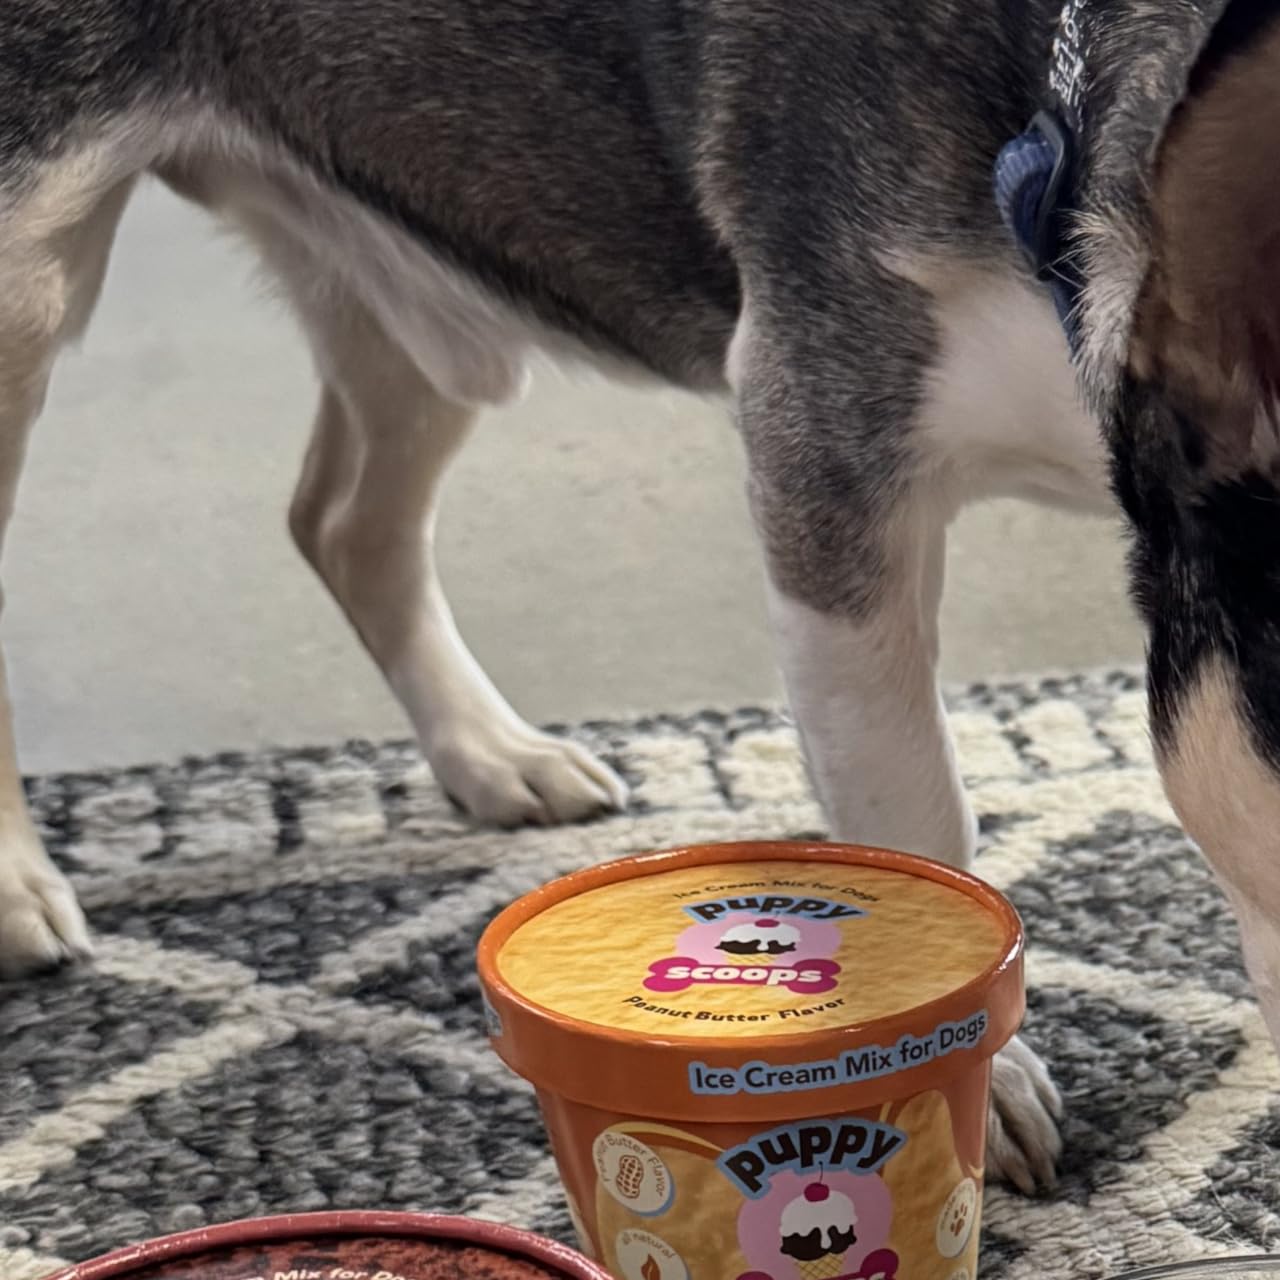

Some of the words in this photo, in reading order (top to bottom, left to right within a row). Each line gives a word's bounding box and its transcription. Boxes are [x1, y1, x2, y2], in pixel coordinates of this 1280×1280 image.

[672, 888, 696, 899] Ice
[703, 880, 766, 893] Cream
[775, 879, 807, 887] Mix
[811, 881, 836, 892] for
[840, 886, 880, 903] Dogs
[695, 895, 863, 921] puppy
[665, 963, 824, 985] scoops
[622, 995, 693, 1019] Peanut
[694, 1010, 771, 1023] Butter
[778, 997, 846, 1019] Flavor
[696, 1066, 736, 1090] Ice
[745, 1064, 835, 1088] Cream
[846, 1050, 893, 1078] Mix
[899, 1038, 934, 1066] for
[939, 1014, 987, 1051] Dogs
[724, 1123, 901, 1193] puppy
[329, 1267, 367, 1280] for
